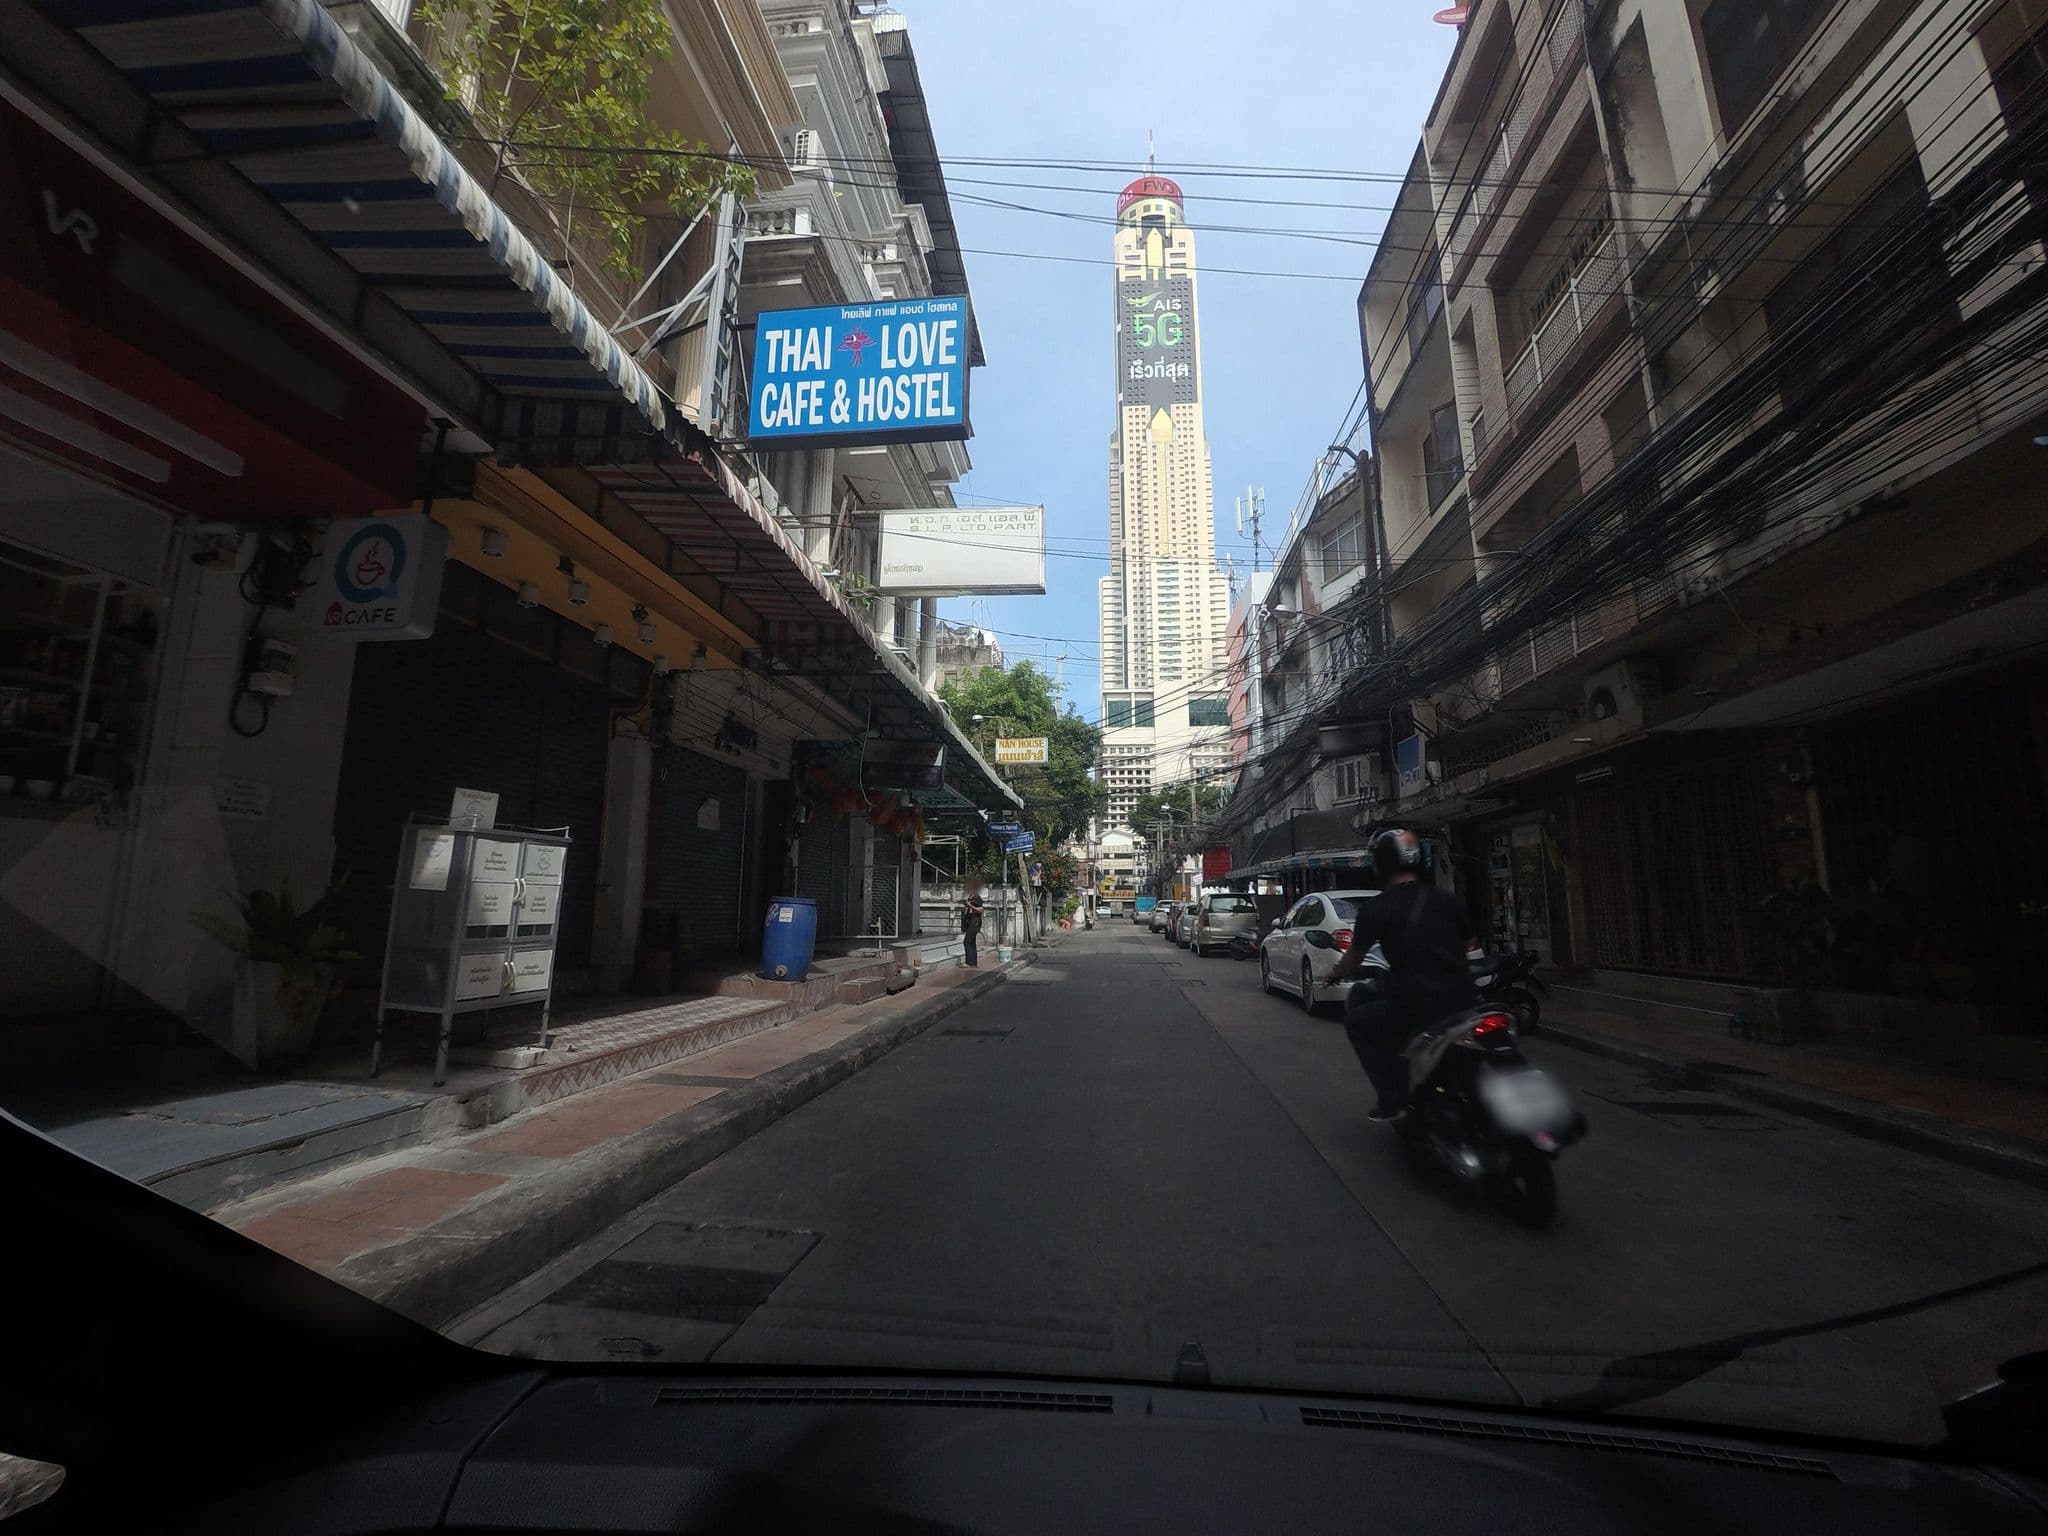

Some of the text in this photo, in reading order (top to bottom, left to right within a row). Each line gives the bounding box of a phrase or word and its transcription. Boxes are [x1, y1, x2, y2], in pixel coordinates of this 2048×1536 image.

[1143, 180, 1175, 194] FWD
[841, 302, 957, 319] ไทยเลิฟ กาแฟ แอนด์ โฮสเทล
[1153, 299, 1182, 311] AIS
[1134, 312, 1183, 348] 5G
[765, 320, 957, 373] THAI LOVE
[1130, 356, 1189, 383] เร็วที่สุด
[760, 372, 956, 429] CAFE & HOSTEL
[344, 607, 398, 625] CAFE
[999, 739, 1045, 749] NAN HOUSE
